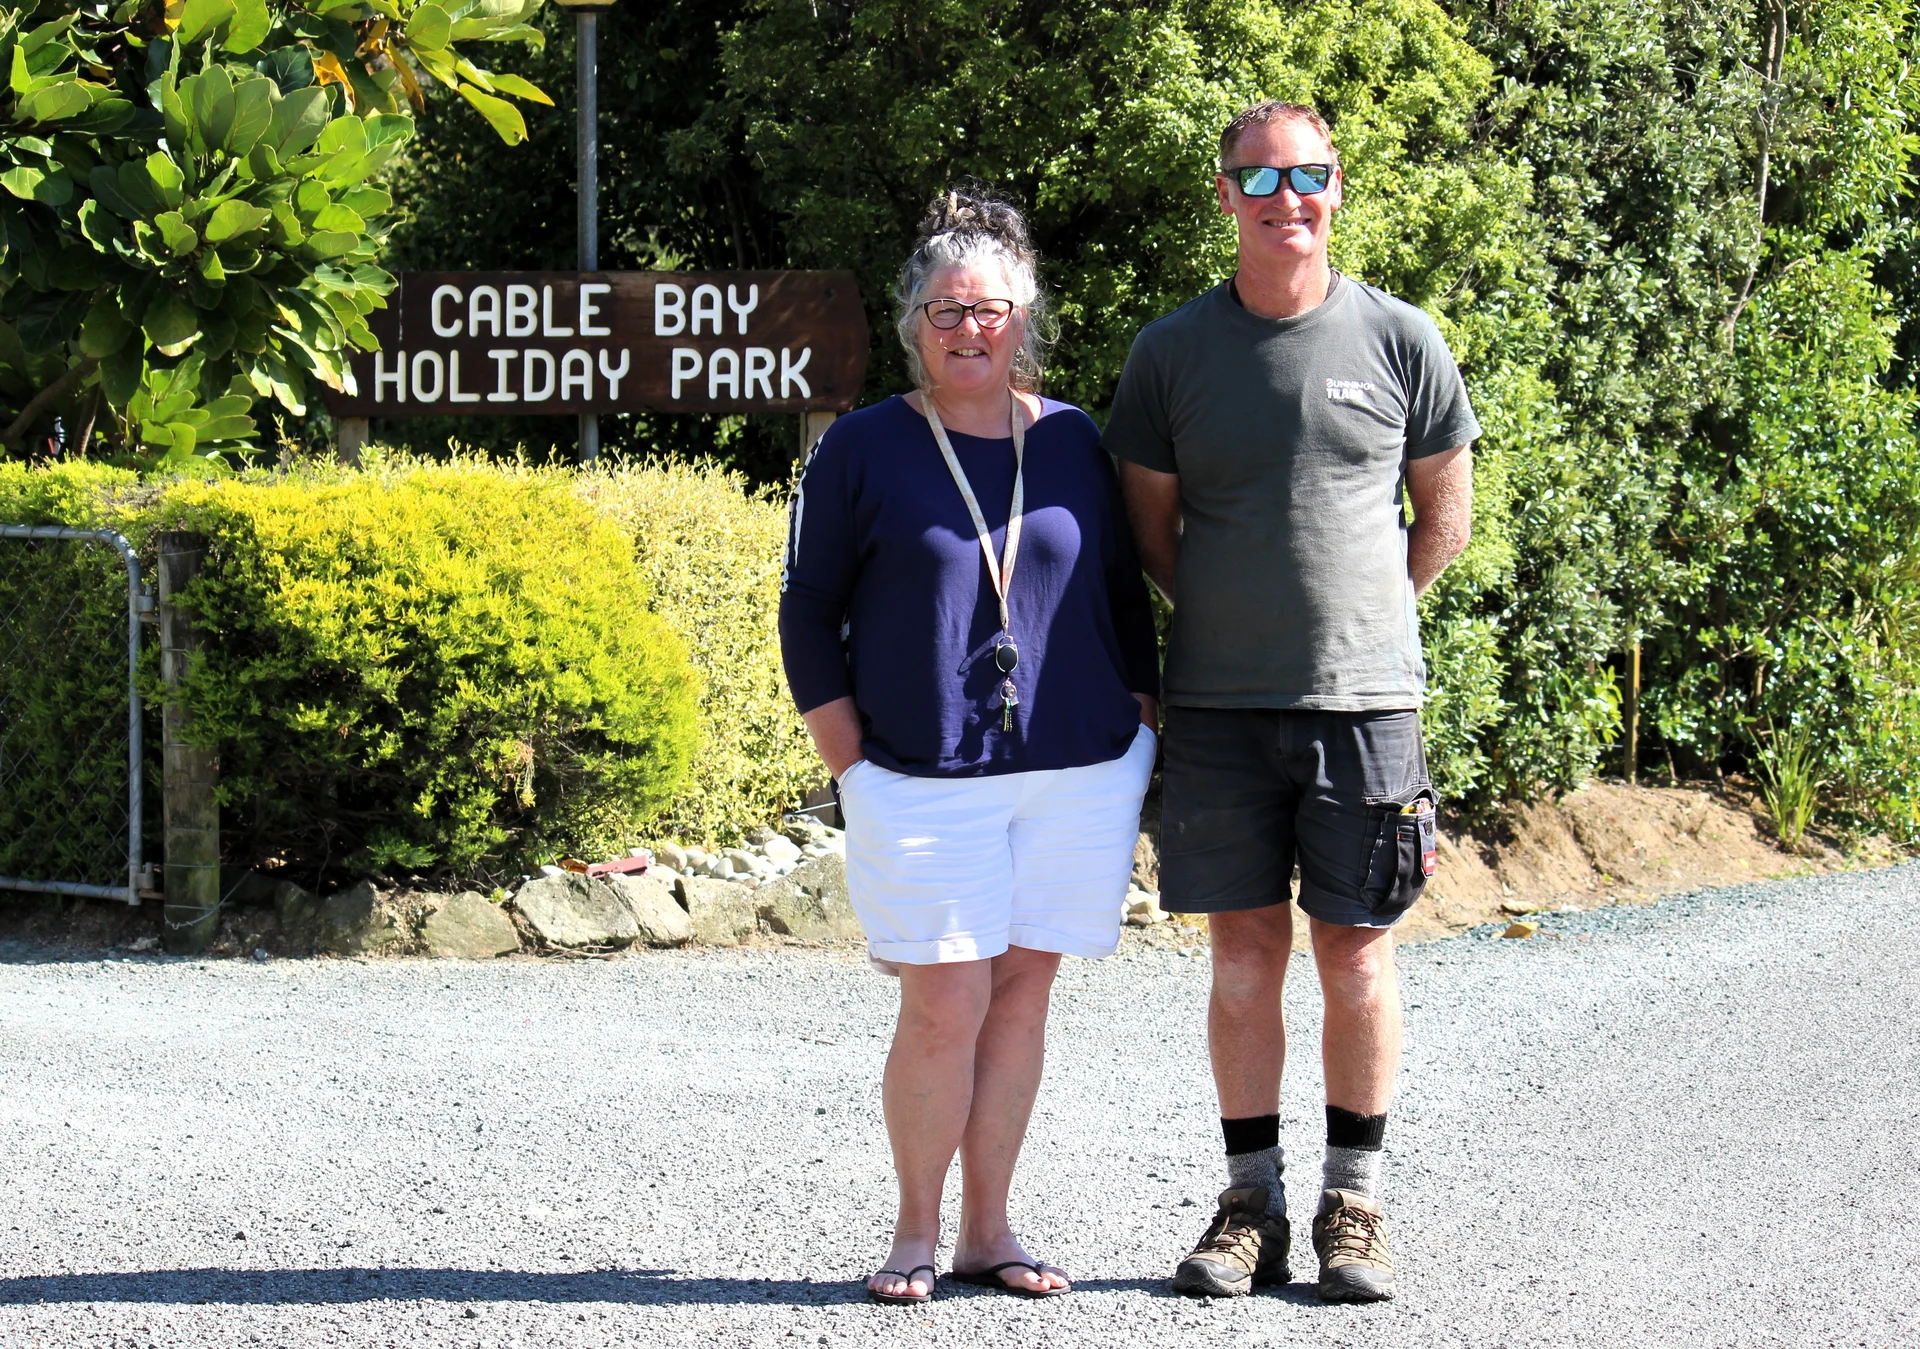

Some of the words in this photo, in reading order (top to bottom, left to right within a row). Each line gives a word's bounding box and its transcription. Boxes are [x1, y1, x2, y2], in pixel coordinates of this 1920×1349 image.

[431, 283, 611, 338] CABLE
[654, 283, 759, 336] BAY
[374, 348, 630, 403] HOLIDAY
[671, 347, 812, 400] PARK
